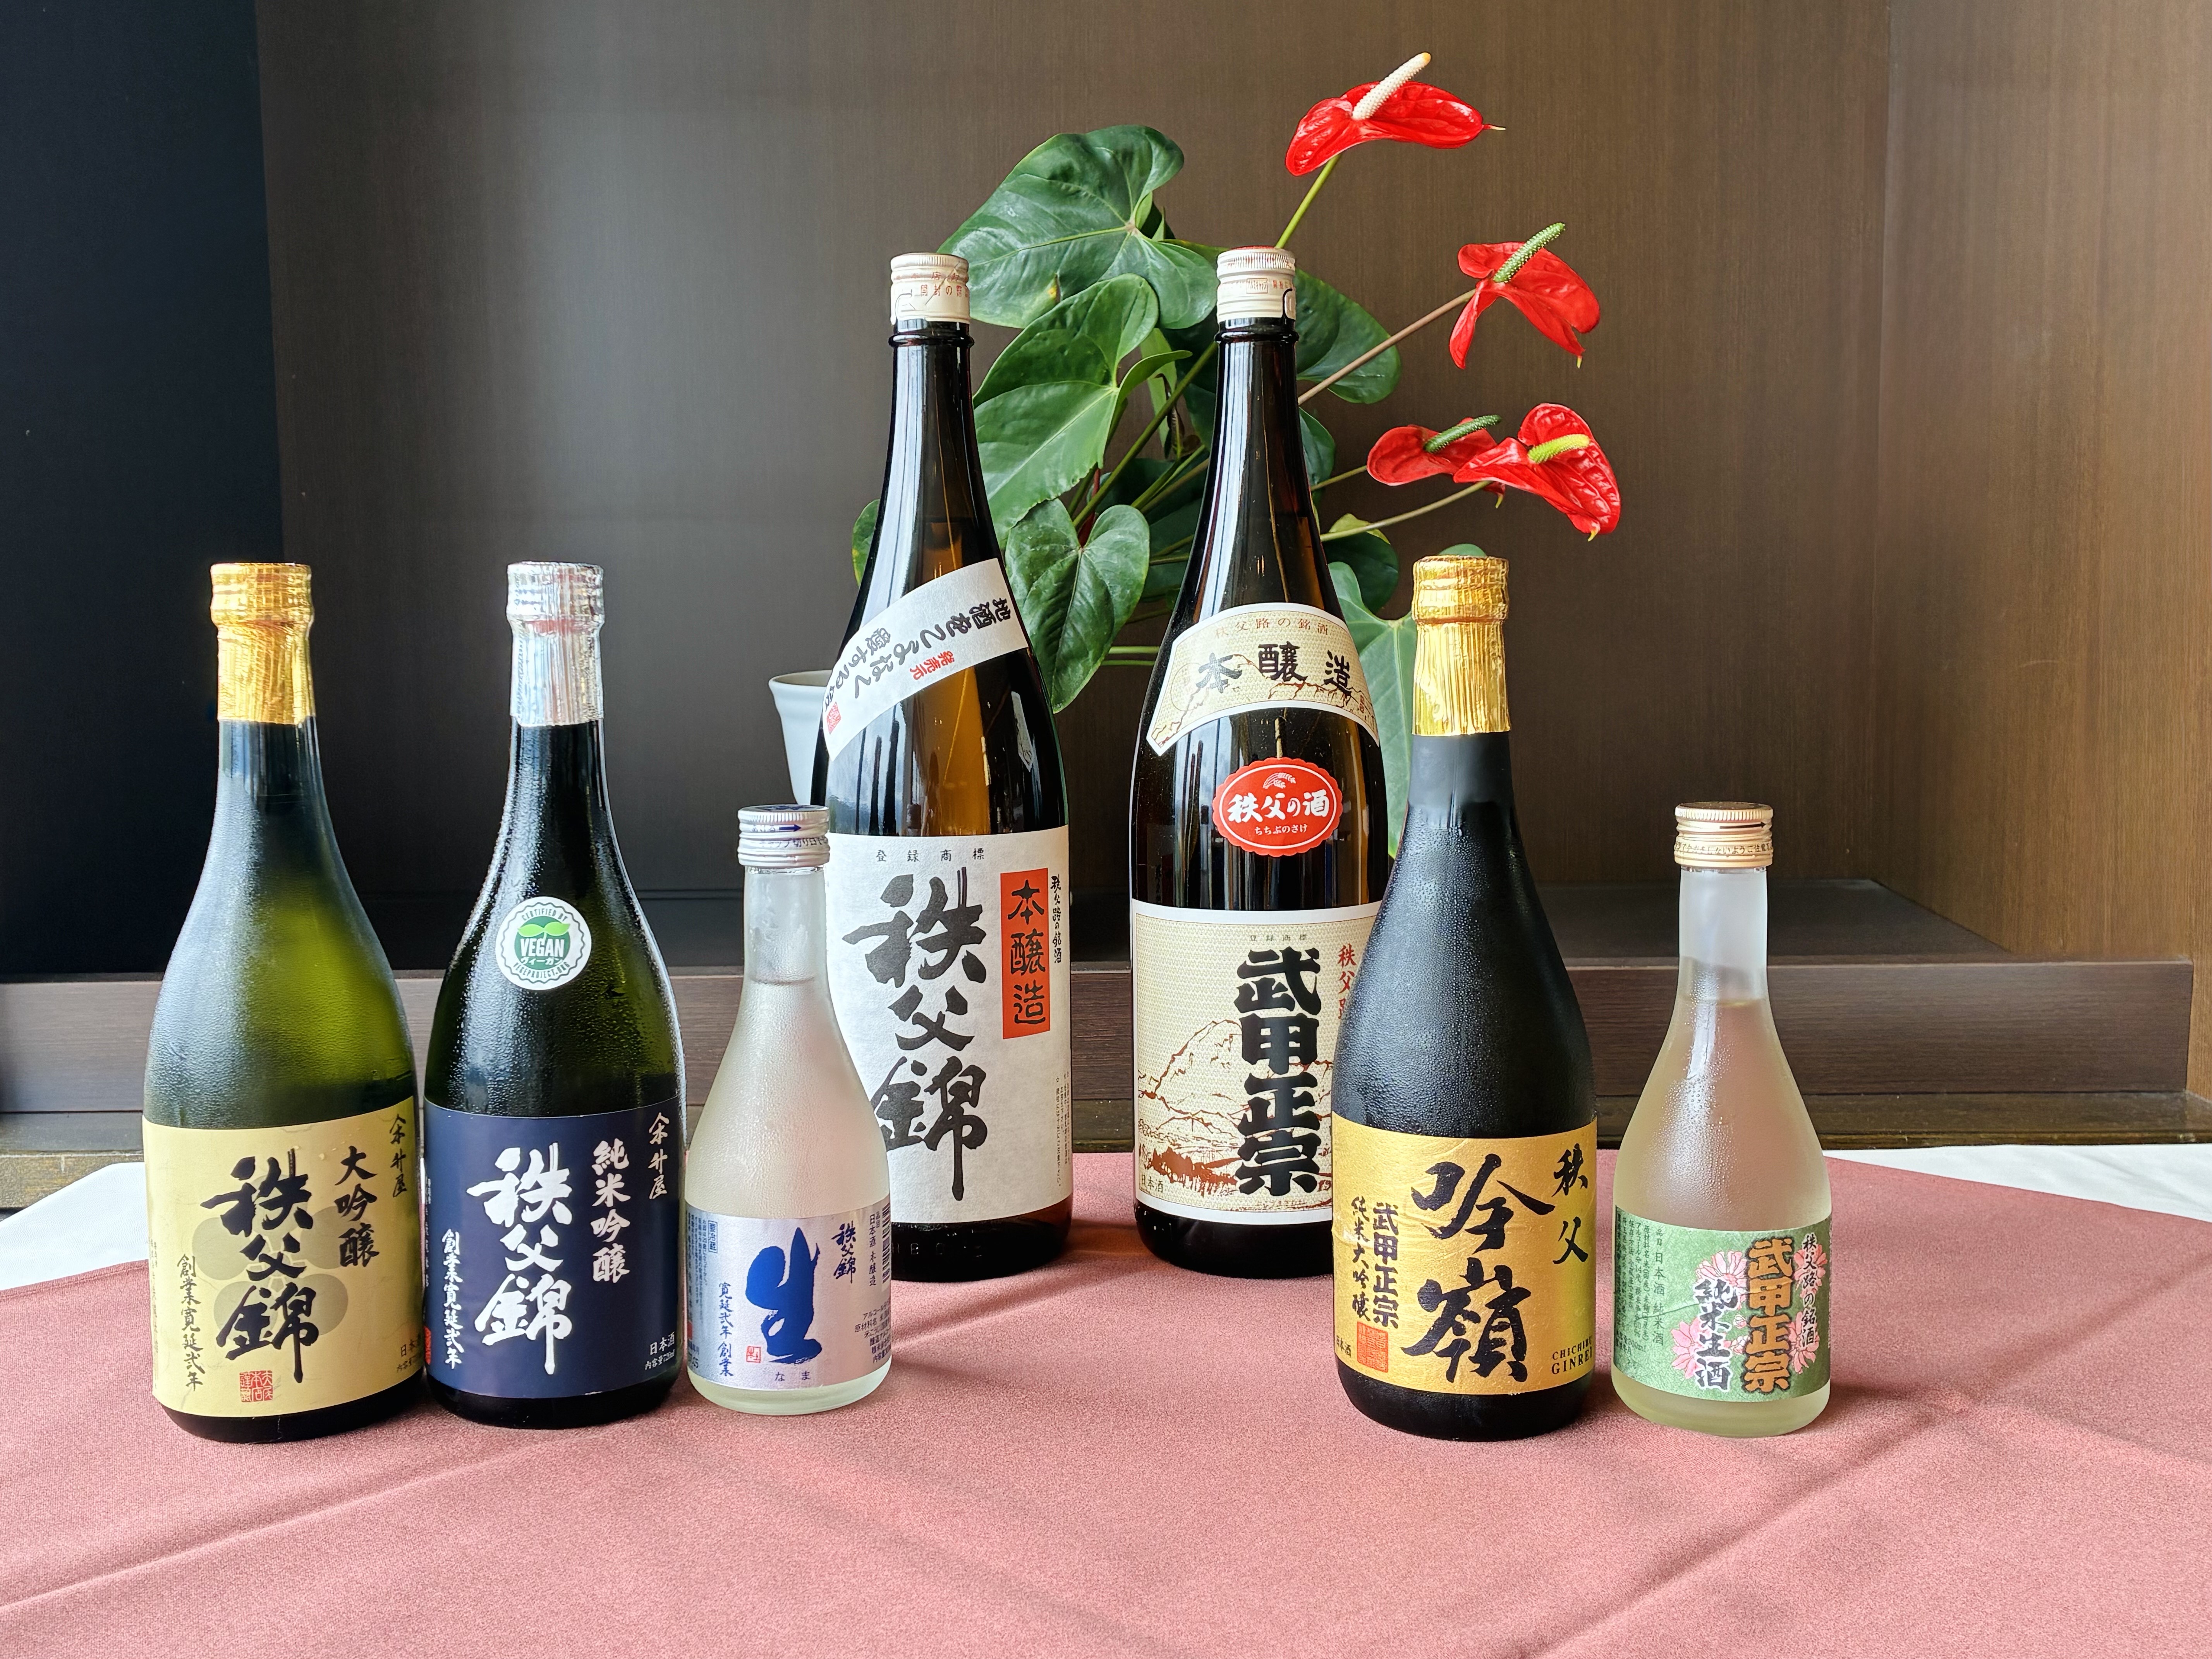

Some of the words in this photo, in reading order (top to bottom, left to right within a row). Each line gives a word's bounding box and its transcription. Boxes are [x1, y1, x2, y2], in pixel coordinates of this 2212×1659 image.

[910, 651, 955, 680] 発売元
[1196, 641, 1352, 695] 本醸造
[1228, 789, 1329, 823] 秩父の酒
[1255, 823, 1307, 835] ちちぶのさけ
[876, 848, 984, 862] 登録商標
[520, 938, 565, 957] VEGAN
[522, 908, 556, 921] CERTIFIED
[558, 913, 568, 922] BY
[1008, 879, 1045, 1025] 本醸造
[1050, 874, 1061, 963] 秩父路の銘酒
[520, 957, 563, 965] ヴィーガン
[842, 867, 987, 1201] 秩父錦
[1234, 946, 1321, 1196] 武甲正宗
[335, 1146, 380, 1267] 大吟醸
[590, 1138, 630, 1283] 純米吟醸
[1142, 1175, 1163, 1193] 日本酒
[1551, 1143, 1588, 1264] 秩父
[201, 1148, 319, 1384] 秩父錦
[466, 1142, 572, 1375] 秩父錦
[745, 1227, 822, 1366] 生
[831, 1220, 856, 1284] 秩父錦
[1351, 1195, 1370, 1322] 純米大吟醸
[1372, 1201, 1399, 1329] 武甲正宗
[1401, 1154, 1555, 1383] 吟嶺
[1654, 1252, 1666, 1295] 日本酒
[1802, 1233, 1818, 1345] 秩父路の銘酒
[650, 1331, 675, 1355] 日本酒
[1336, 1335, 1351, 1358] 日本酒
[1695, 1278, 1739, 1389] 純米生酒
[1744, 1238, 1792, 1393] 武甲正宗
[775, 1371, 811, 1382] なま
[1552, 1346, 1592, 1375] GINREI
